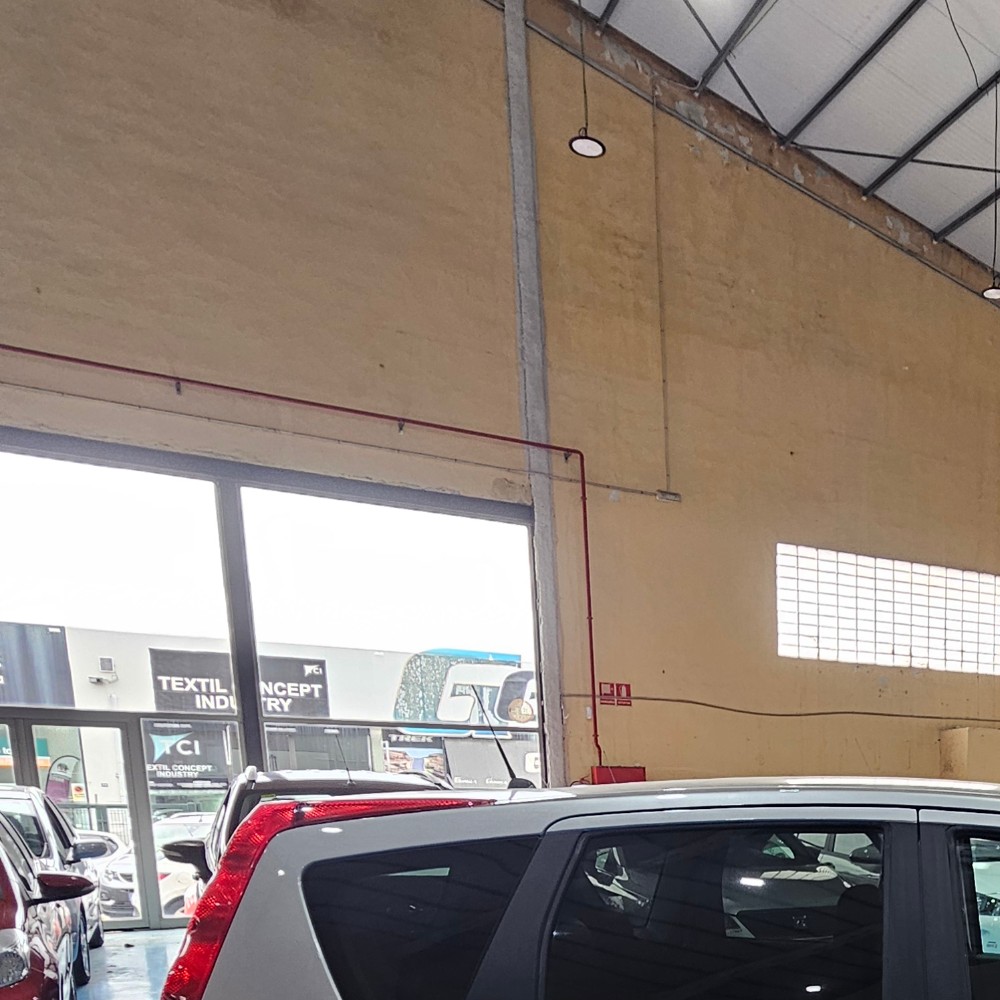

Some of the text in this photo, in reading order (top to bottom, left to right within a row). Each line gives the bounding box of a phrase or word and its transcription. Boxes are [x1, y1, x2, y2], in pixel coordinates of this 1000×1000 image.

[157, 676, 323, 698] TEXTIL NCEPT
[147, 763, 213, 772] EXTIL CONCEPT
[156, 770, 199, 778] INDUSTRY
